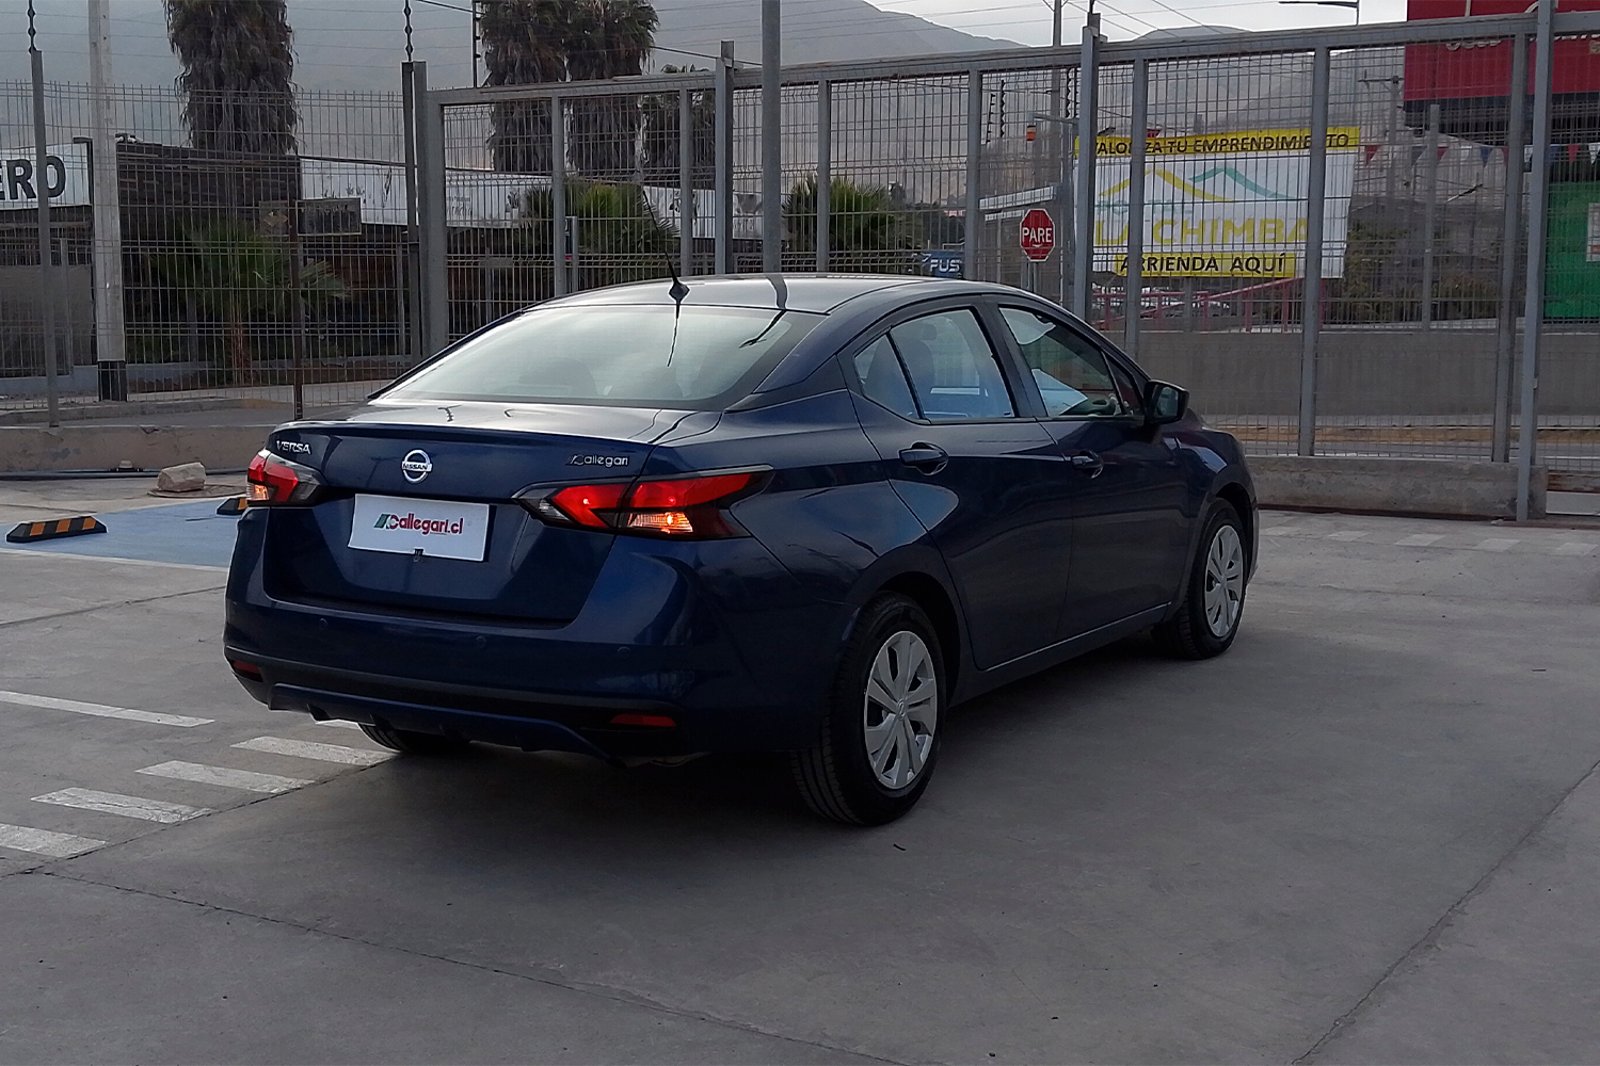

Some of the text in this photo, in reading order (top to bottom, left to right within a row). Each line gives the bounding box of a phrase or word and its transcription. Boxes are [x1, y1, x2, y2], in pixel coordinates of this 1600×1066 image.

[1095, 133, 1349, 155] ALOZA TU EMPRENDIMIETO
[0, 155, 66, 200] RO
[1022, 226, 1053, 243] PARE
[1230, 252, 1286, 274] AQUÍ
[276, 440, 311, 455] VERSA
[402, 462, 429, 471] NISSAN
